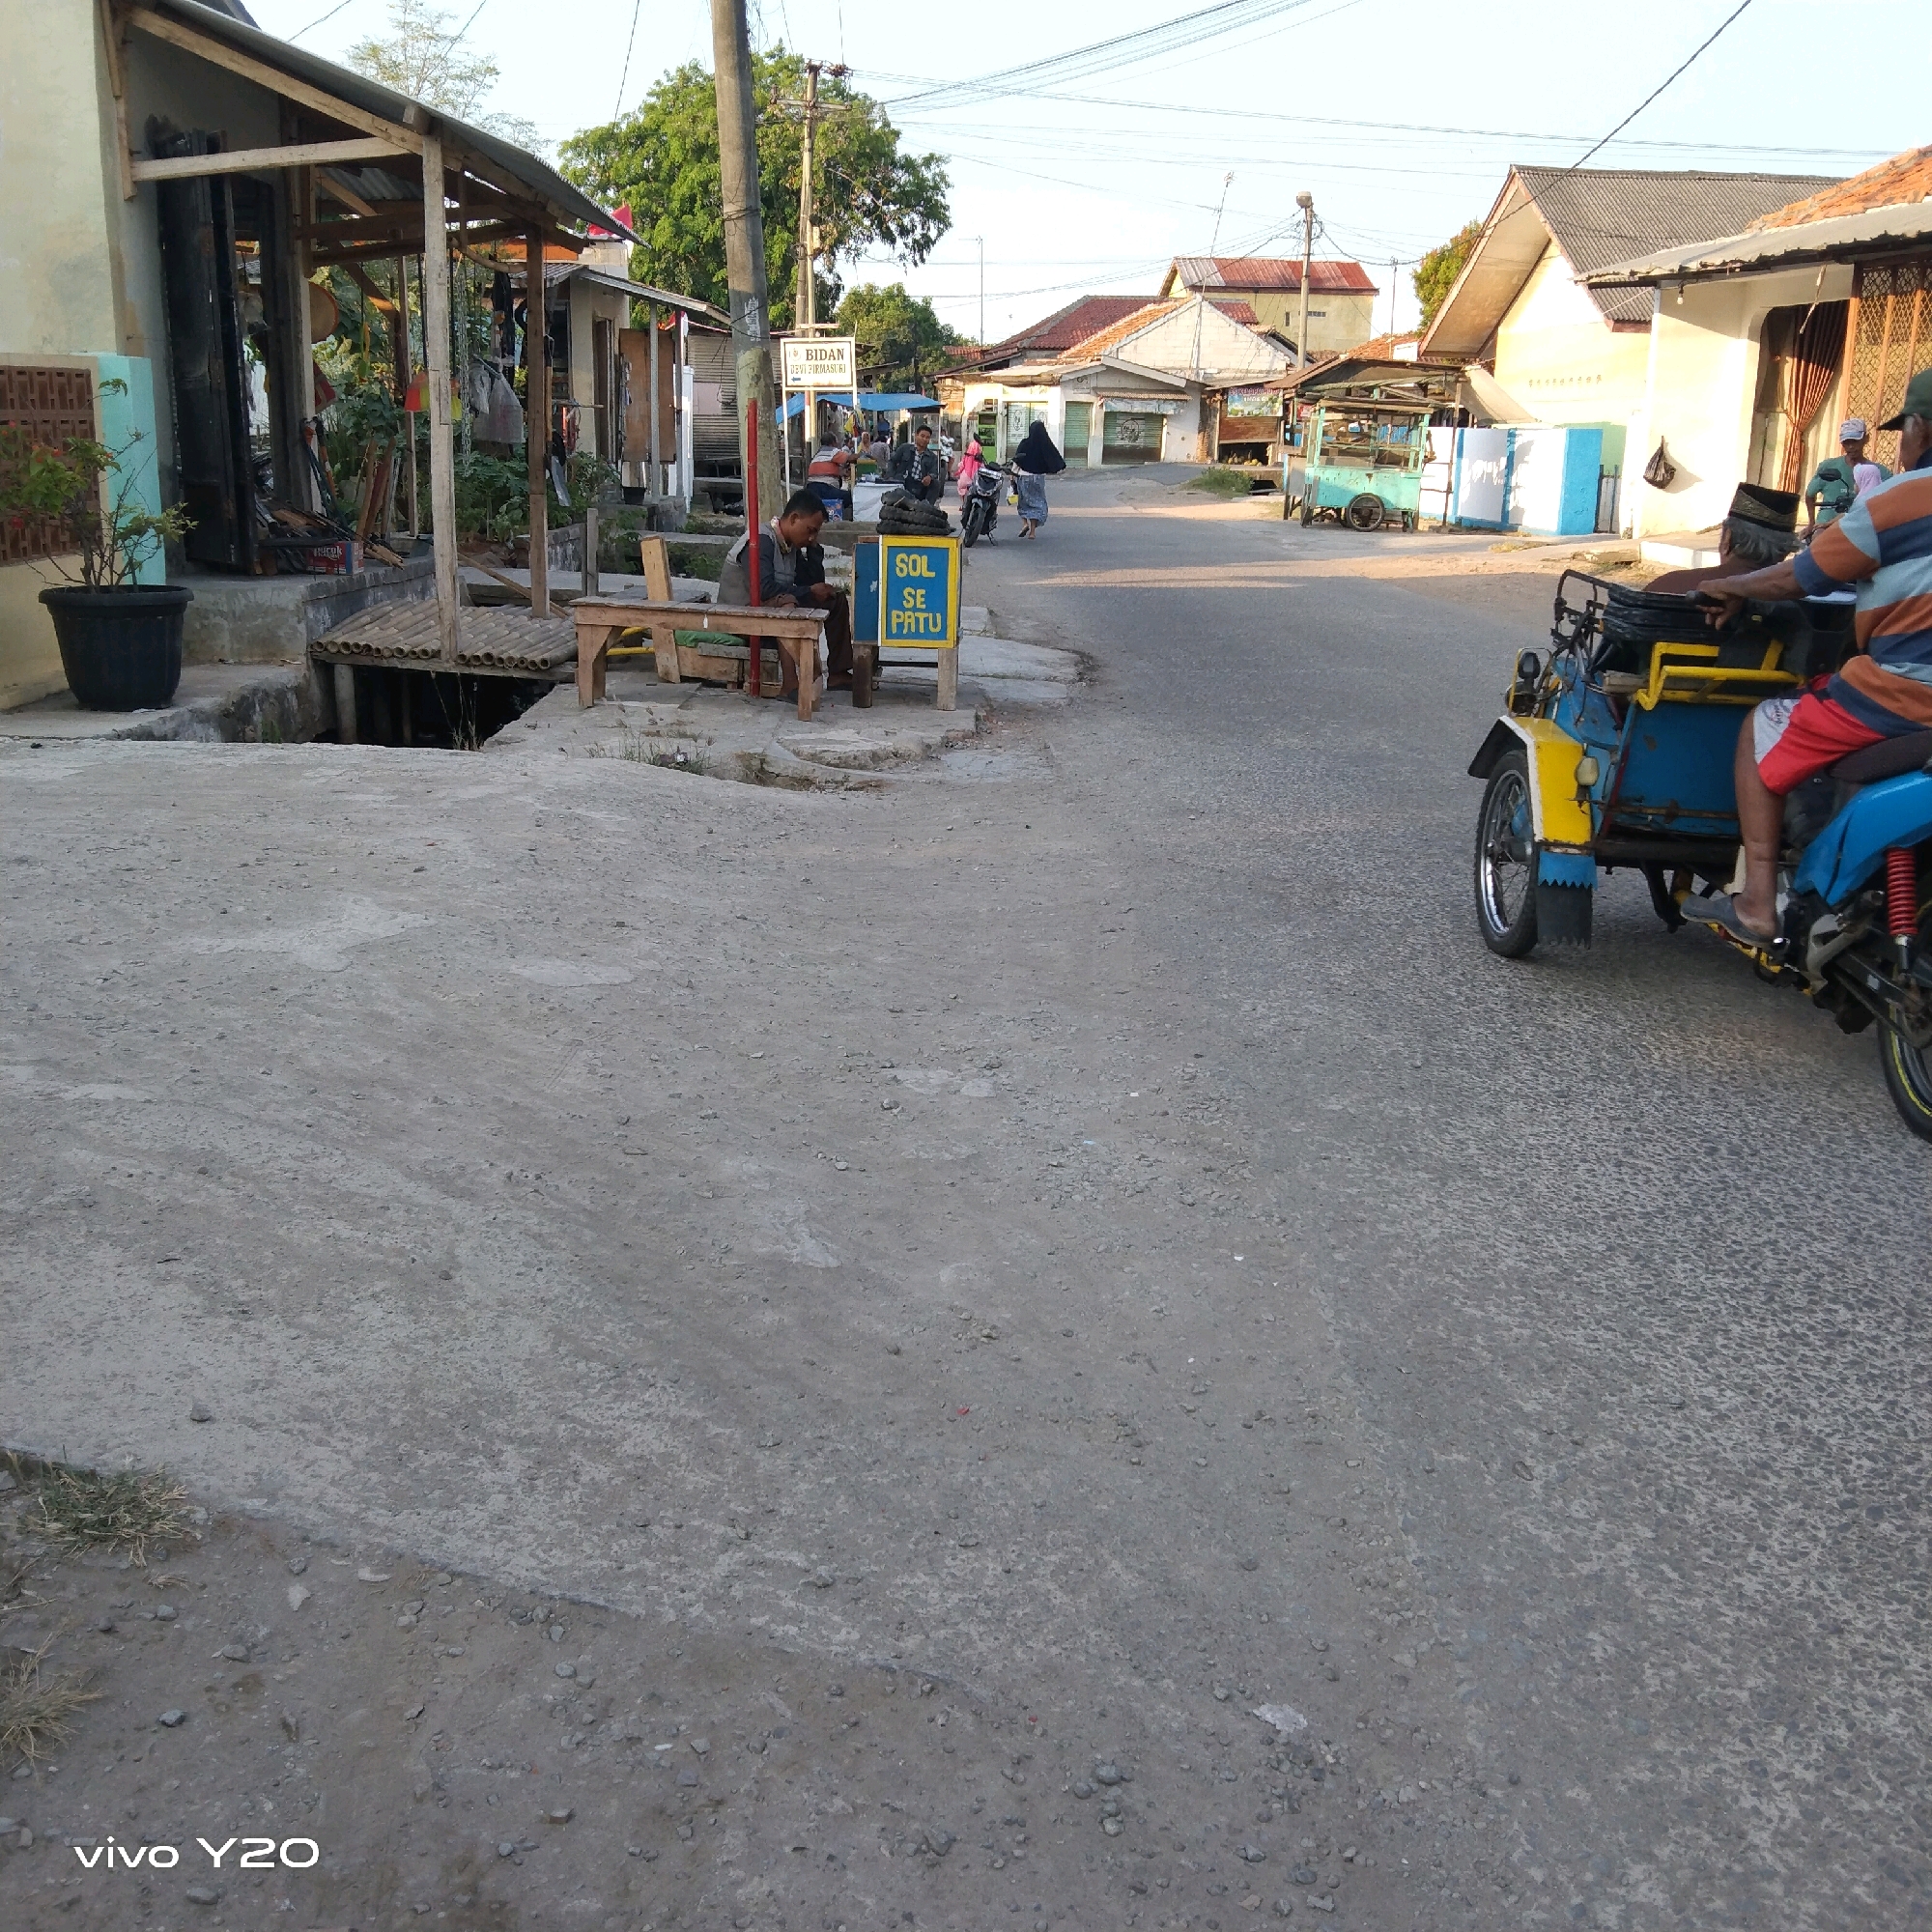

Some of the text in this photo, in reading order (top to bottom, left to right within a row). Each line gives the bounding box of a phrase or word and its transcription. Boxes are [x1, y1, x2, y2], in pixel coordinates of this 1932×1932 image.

[806, 348, 844, 361] BIDAN
[895, 553, 936, 578] SOL
[902, 586, 926, 610] SE
[891, 610, 942, 635] PATU
